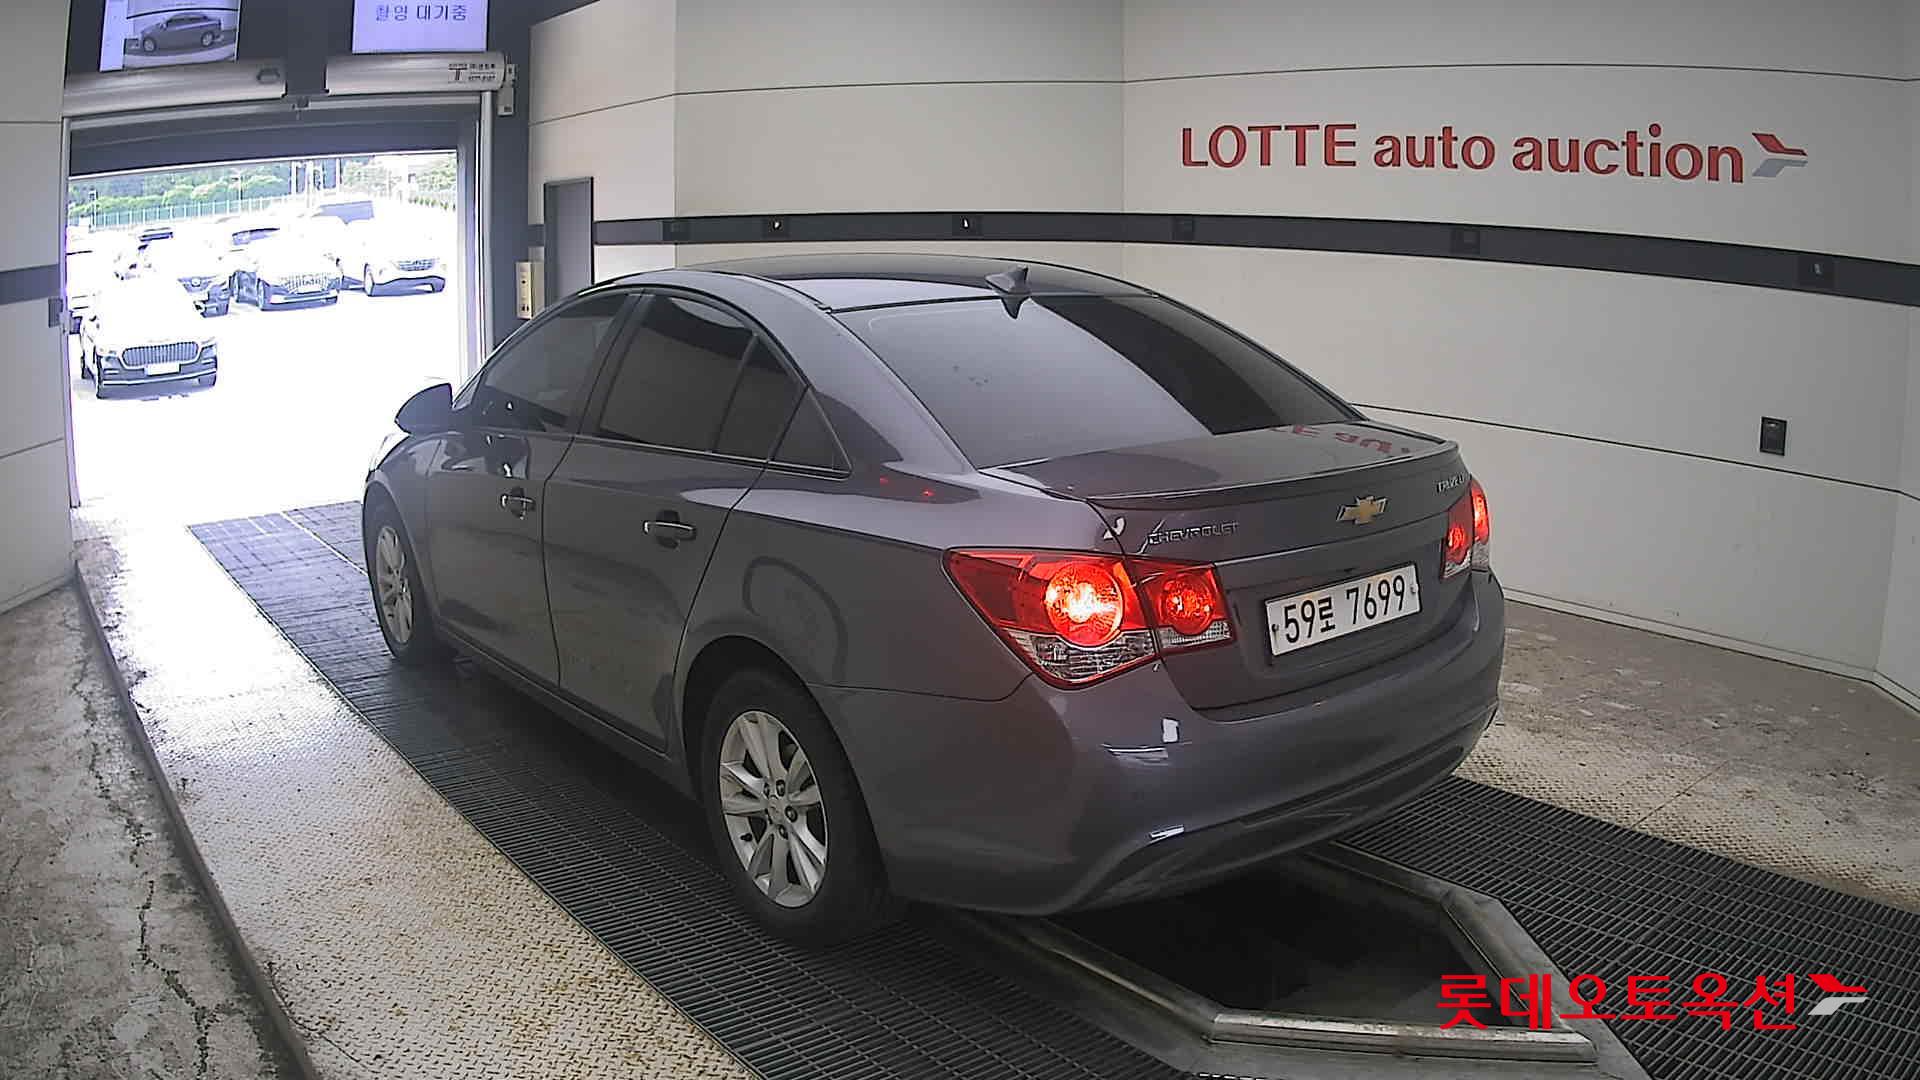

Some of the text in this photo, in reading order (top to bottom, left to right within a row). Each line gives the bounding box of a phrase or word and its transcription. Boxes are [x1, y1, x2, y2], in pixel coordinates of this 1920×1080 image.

[416, 4, 468, 21] 대기중
[1181, 123, 1744, 184] LOTTE auto auction
[1283, 574, 1406, 644] 59로 7699
